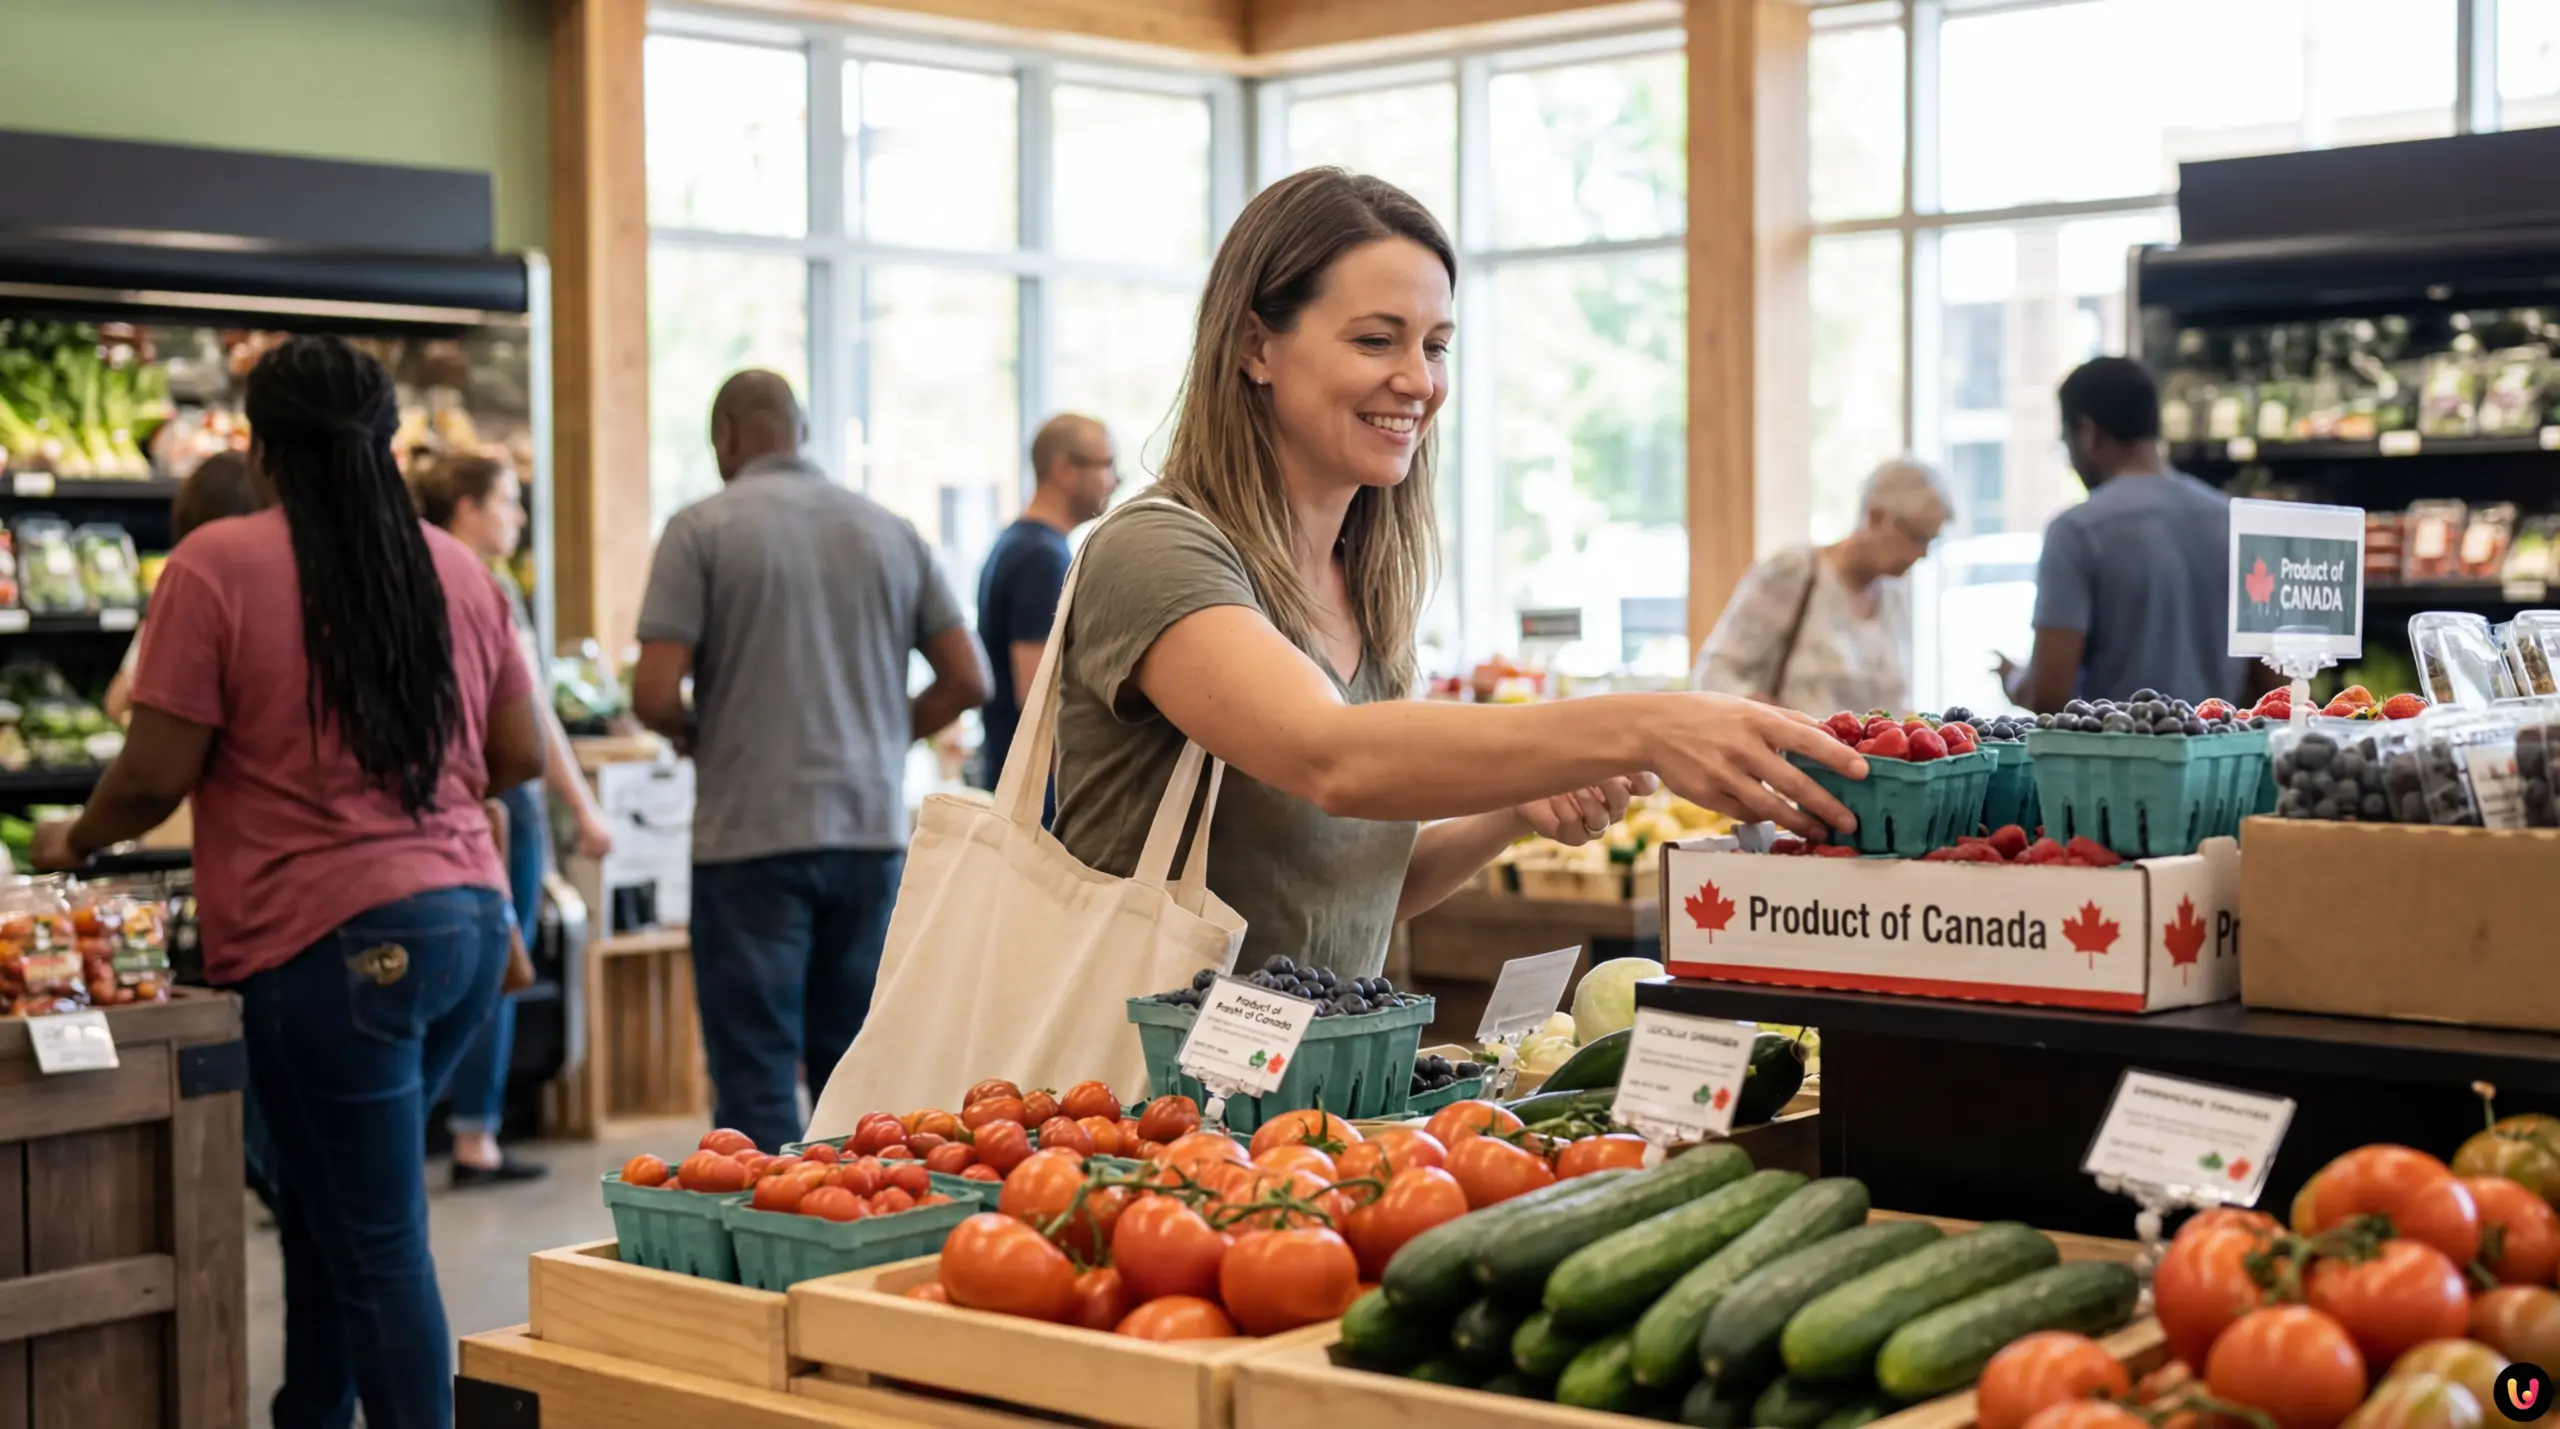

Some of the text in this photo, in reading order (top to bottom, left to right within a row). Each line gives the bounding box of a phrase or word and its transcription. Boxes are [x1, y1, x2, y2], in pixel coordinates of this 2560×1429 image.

[2280, 557, 2345, 582] Product of
[2280, 585, 2343, 612] CANADA
[1749, 895, 2046, 950] Product of Canada
[1255, 1013, 1292, 1031] Canada
